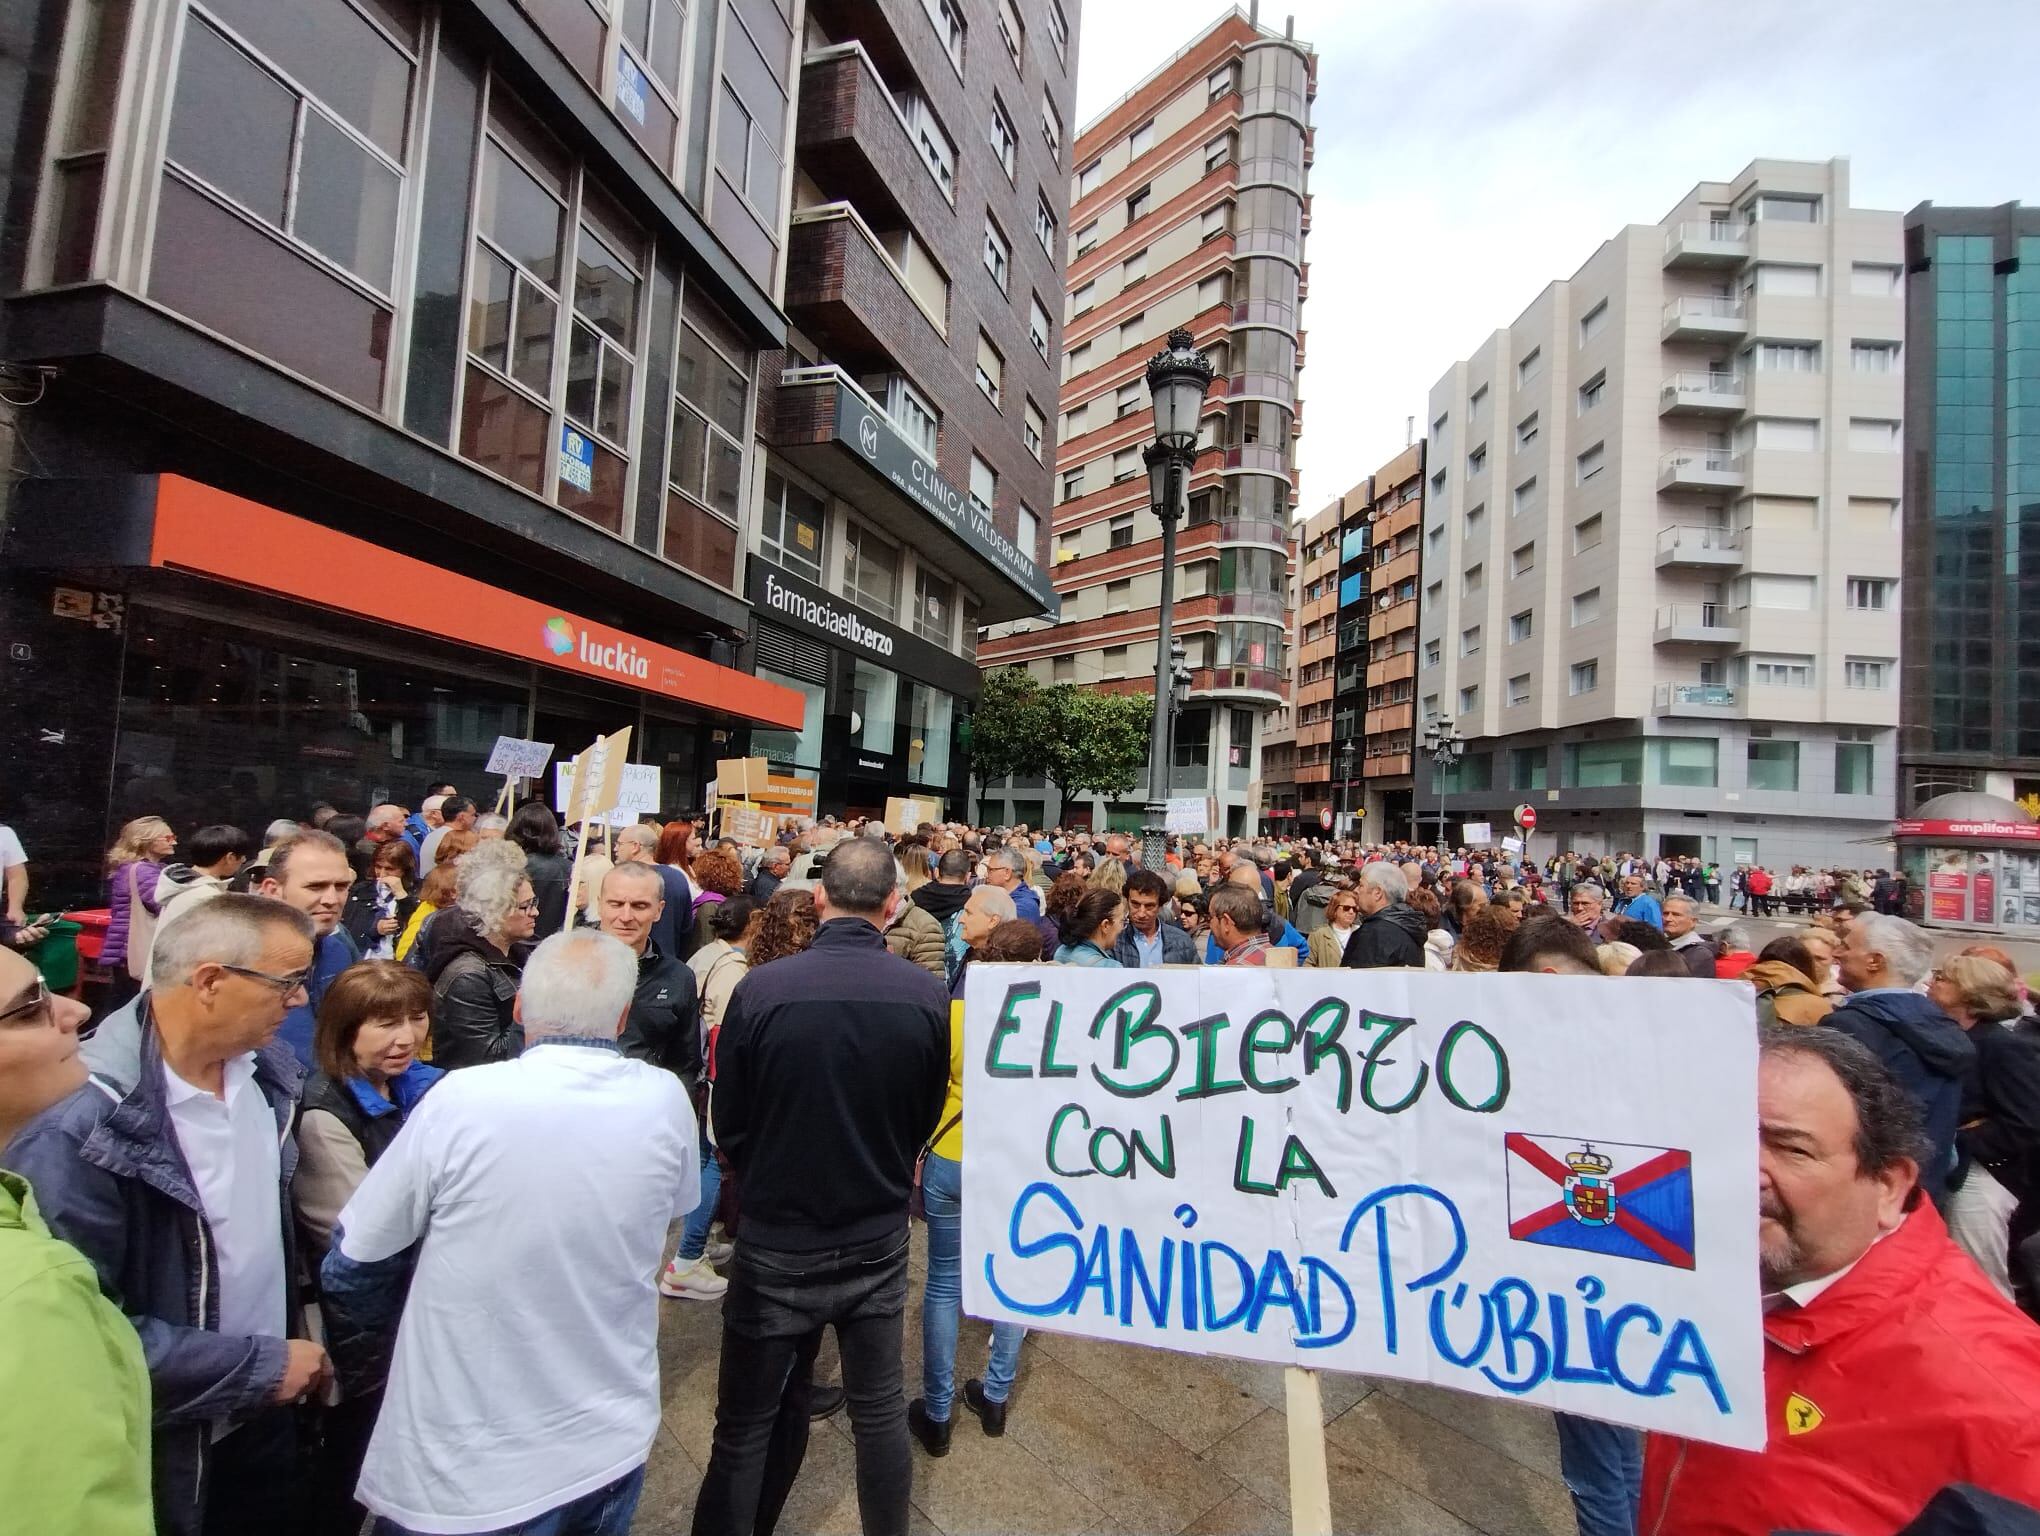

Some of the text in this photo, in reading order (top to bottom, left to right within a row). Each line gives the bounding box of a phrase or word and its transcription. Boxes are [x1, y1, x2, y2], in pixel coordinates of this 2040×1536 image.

[912, 459, 1034, 581] CLINICA VALDERRAMA
[580, 631, 648, 679] luckia
[1949, 822, 2014, 835] amplifon
[984, 980, 1078, 1078] EL
[1234, 1115, 1338, 1198] LA
